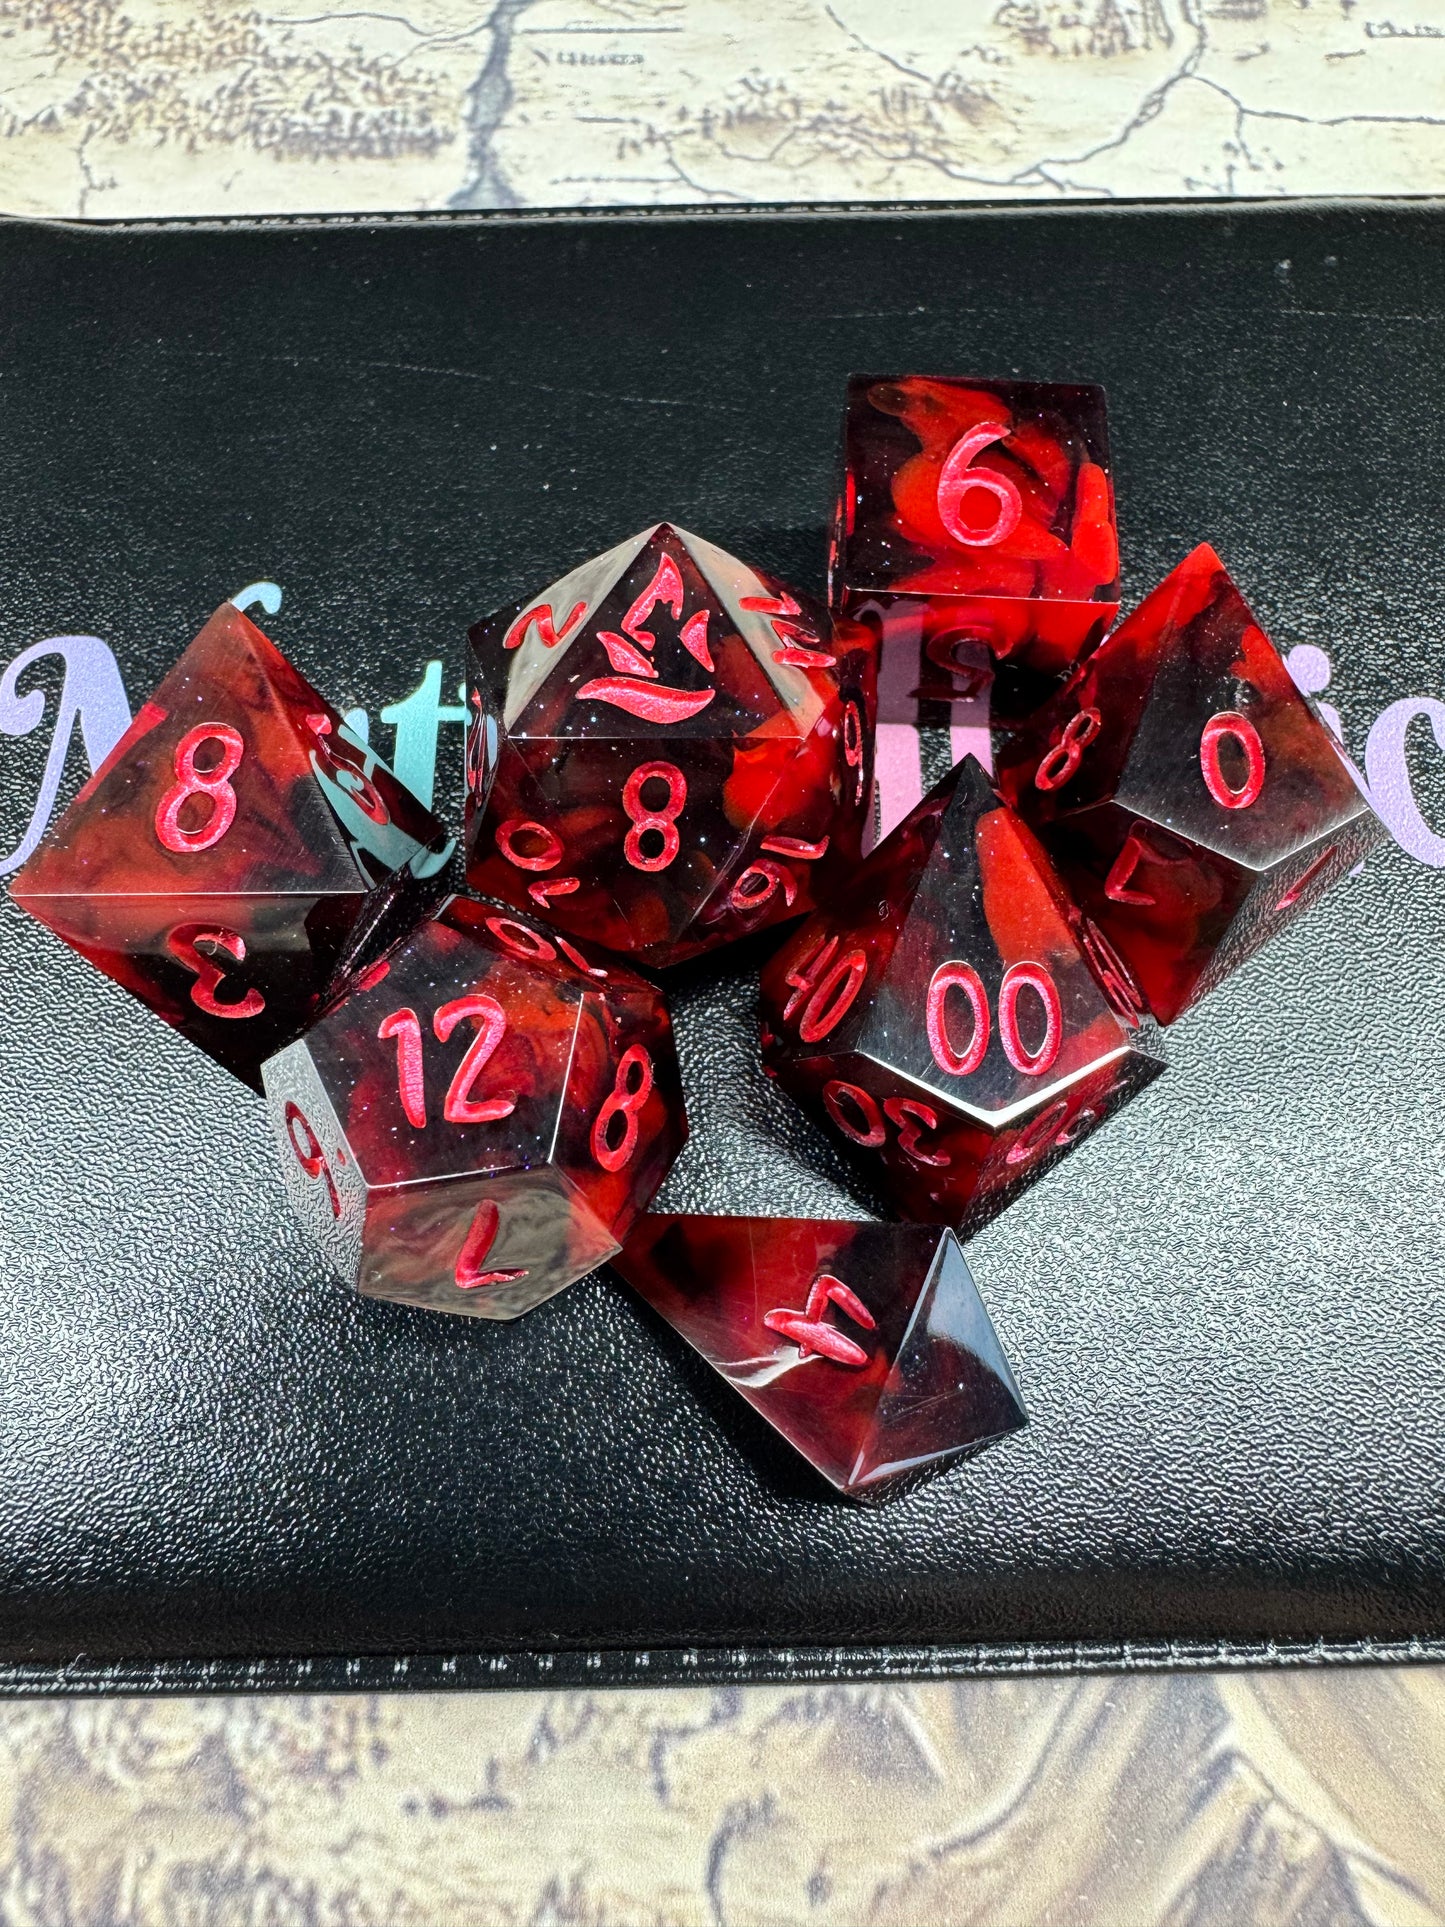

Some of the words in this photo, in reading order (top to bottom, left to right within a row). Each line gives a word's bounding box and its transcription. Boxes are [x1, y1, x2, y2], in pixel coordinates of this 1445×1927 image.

[937, 421, 1022, 546] 6
[155, 721, 244, 852] 8
[1035, 707, 1101, 791] 8
[1201, 711, 1265, 809] 0
[622, 760, 687, 872] 8
[166, 923, 266, 1018] 3
[926, 960, 1062, 1076] 00
[378, 994, 516, 1129] 12
[590, 1044, 653, 1172] 8
[455, 1200, 529, 1289] 7
[763, 1274, 876, 1366] 4
